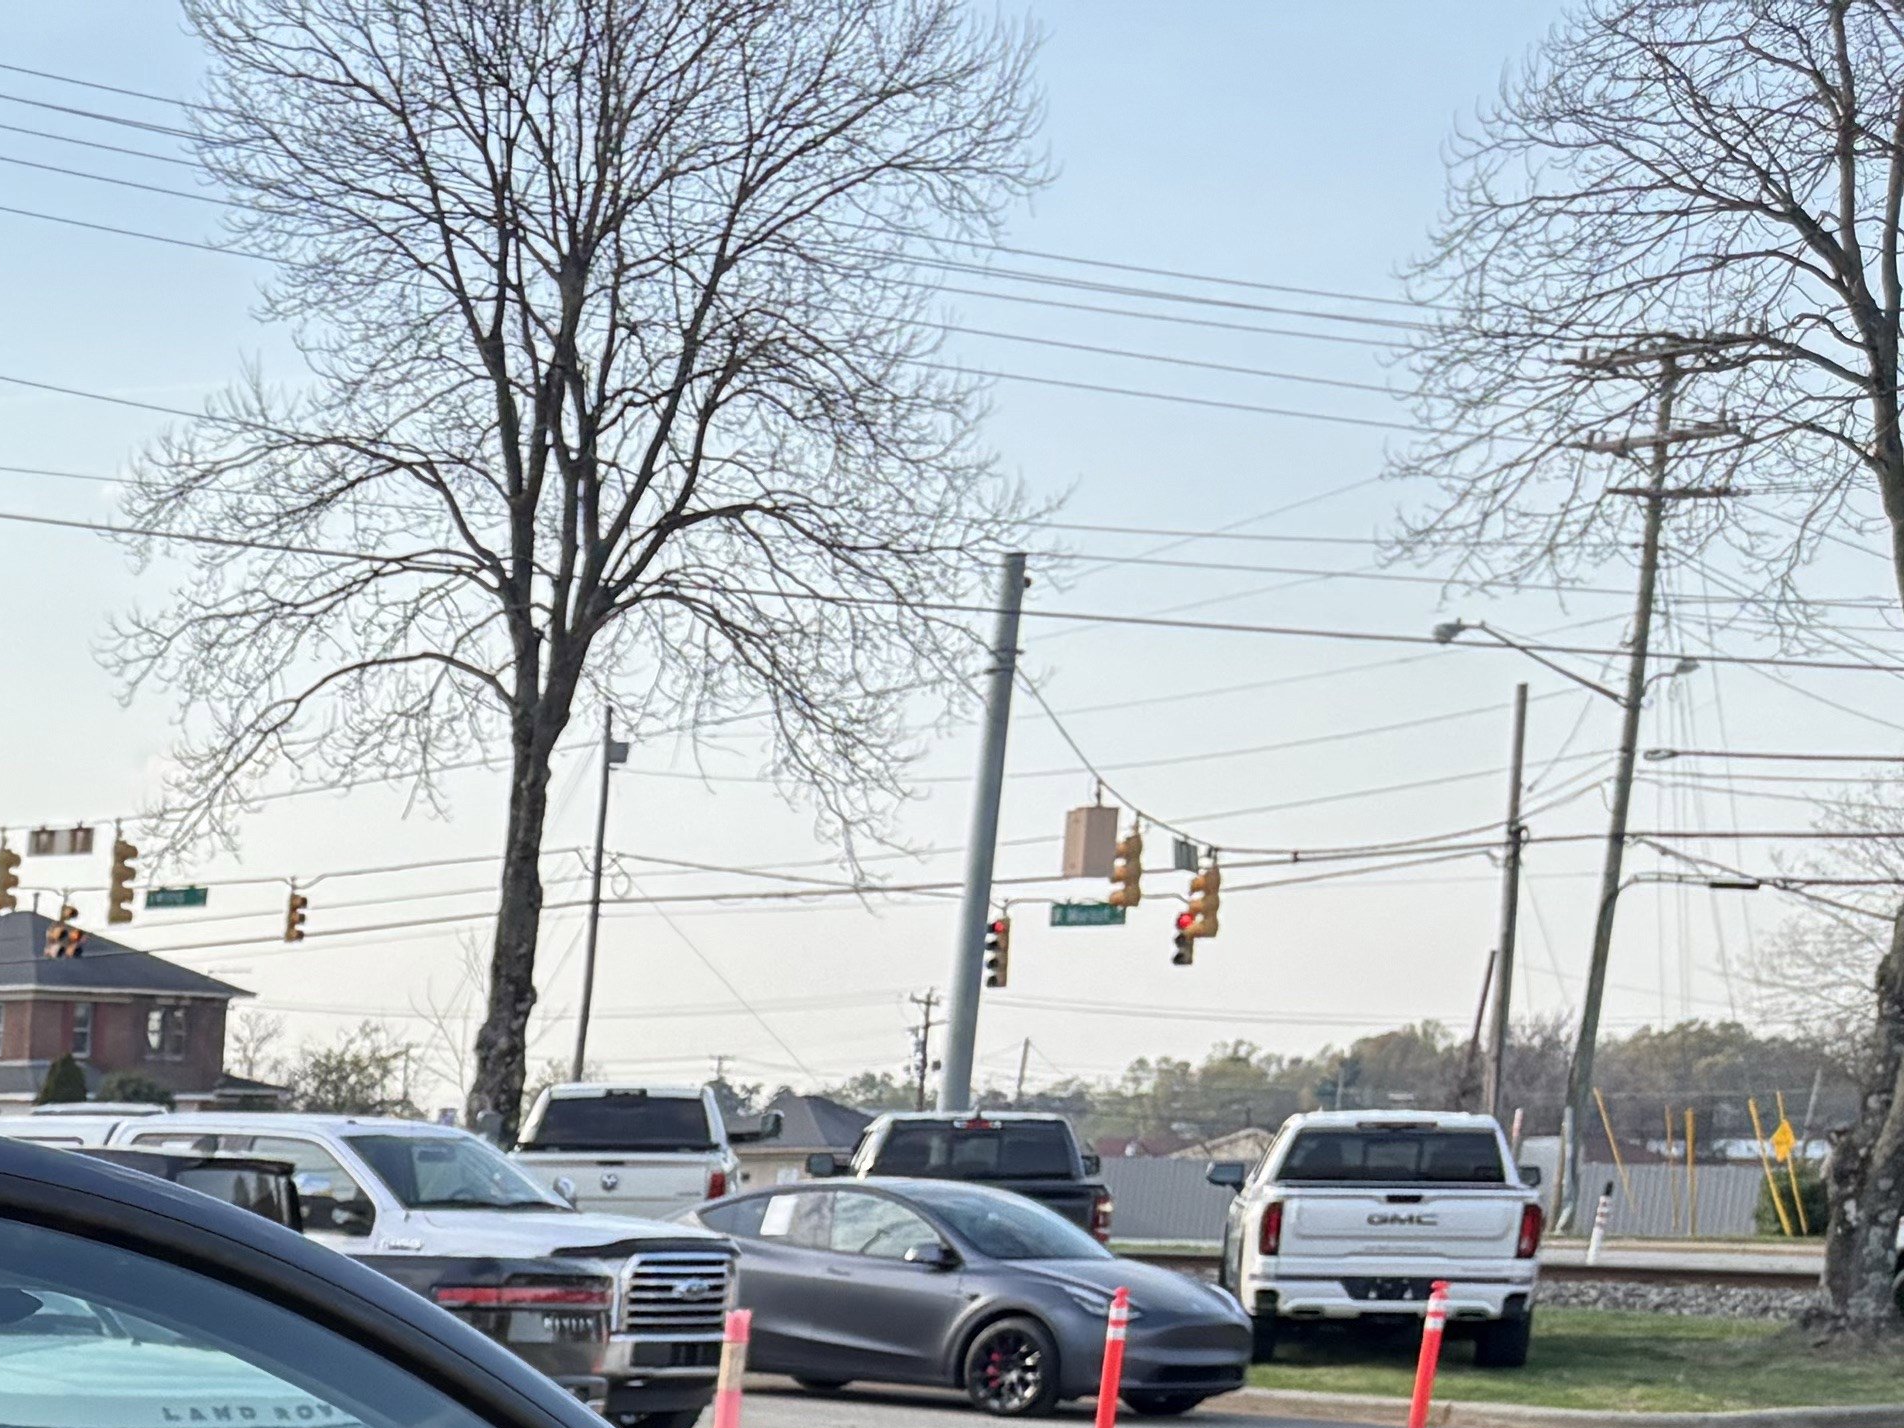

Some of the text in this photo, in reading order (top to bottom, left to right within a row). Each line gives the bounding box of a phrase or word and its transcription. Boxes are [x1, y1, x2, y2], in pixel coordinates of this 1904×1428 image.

[1366, 1213, 1438, 1227] GMC
[162, 1403, 334, 1422] LAND ROV
